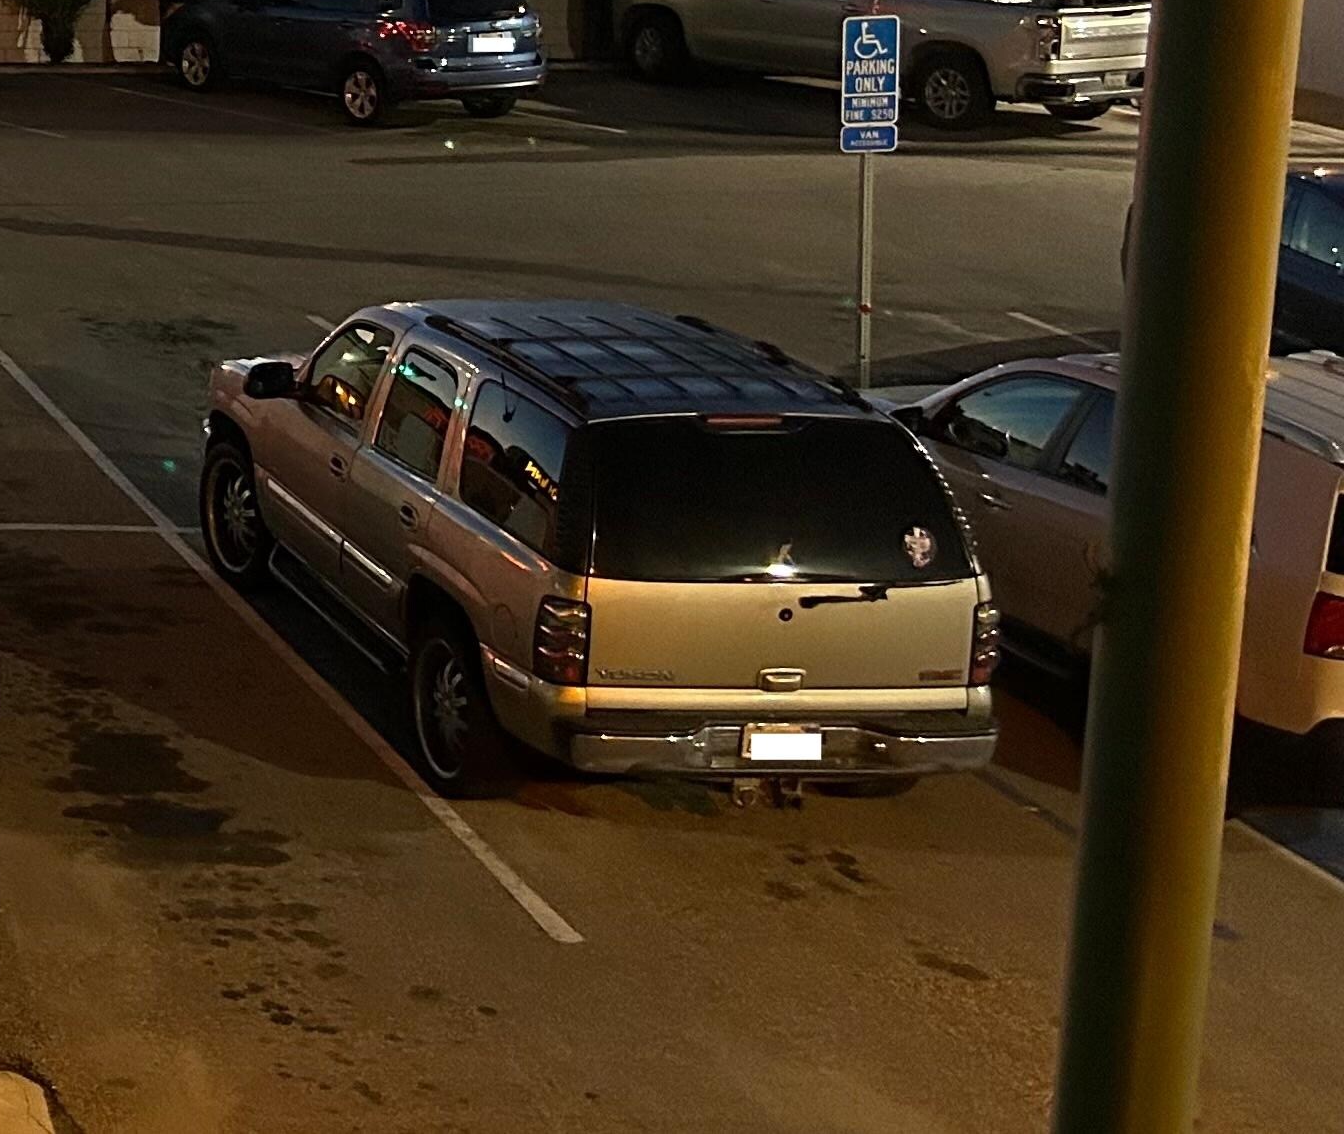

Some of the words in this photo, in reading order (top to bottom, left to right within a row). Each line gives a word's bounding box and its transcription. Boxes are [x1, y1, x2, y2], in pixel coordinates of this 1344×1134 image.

[846, 59, 895, 76] PARKING
[854, 76, 886, 93] ONLY
[852, 97, 888, 108] MINIMUM
[845, 110, 864, 121] FINE
[871, 109, 894, 121] $250
[859, 130, 879, 139] VAN
